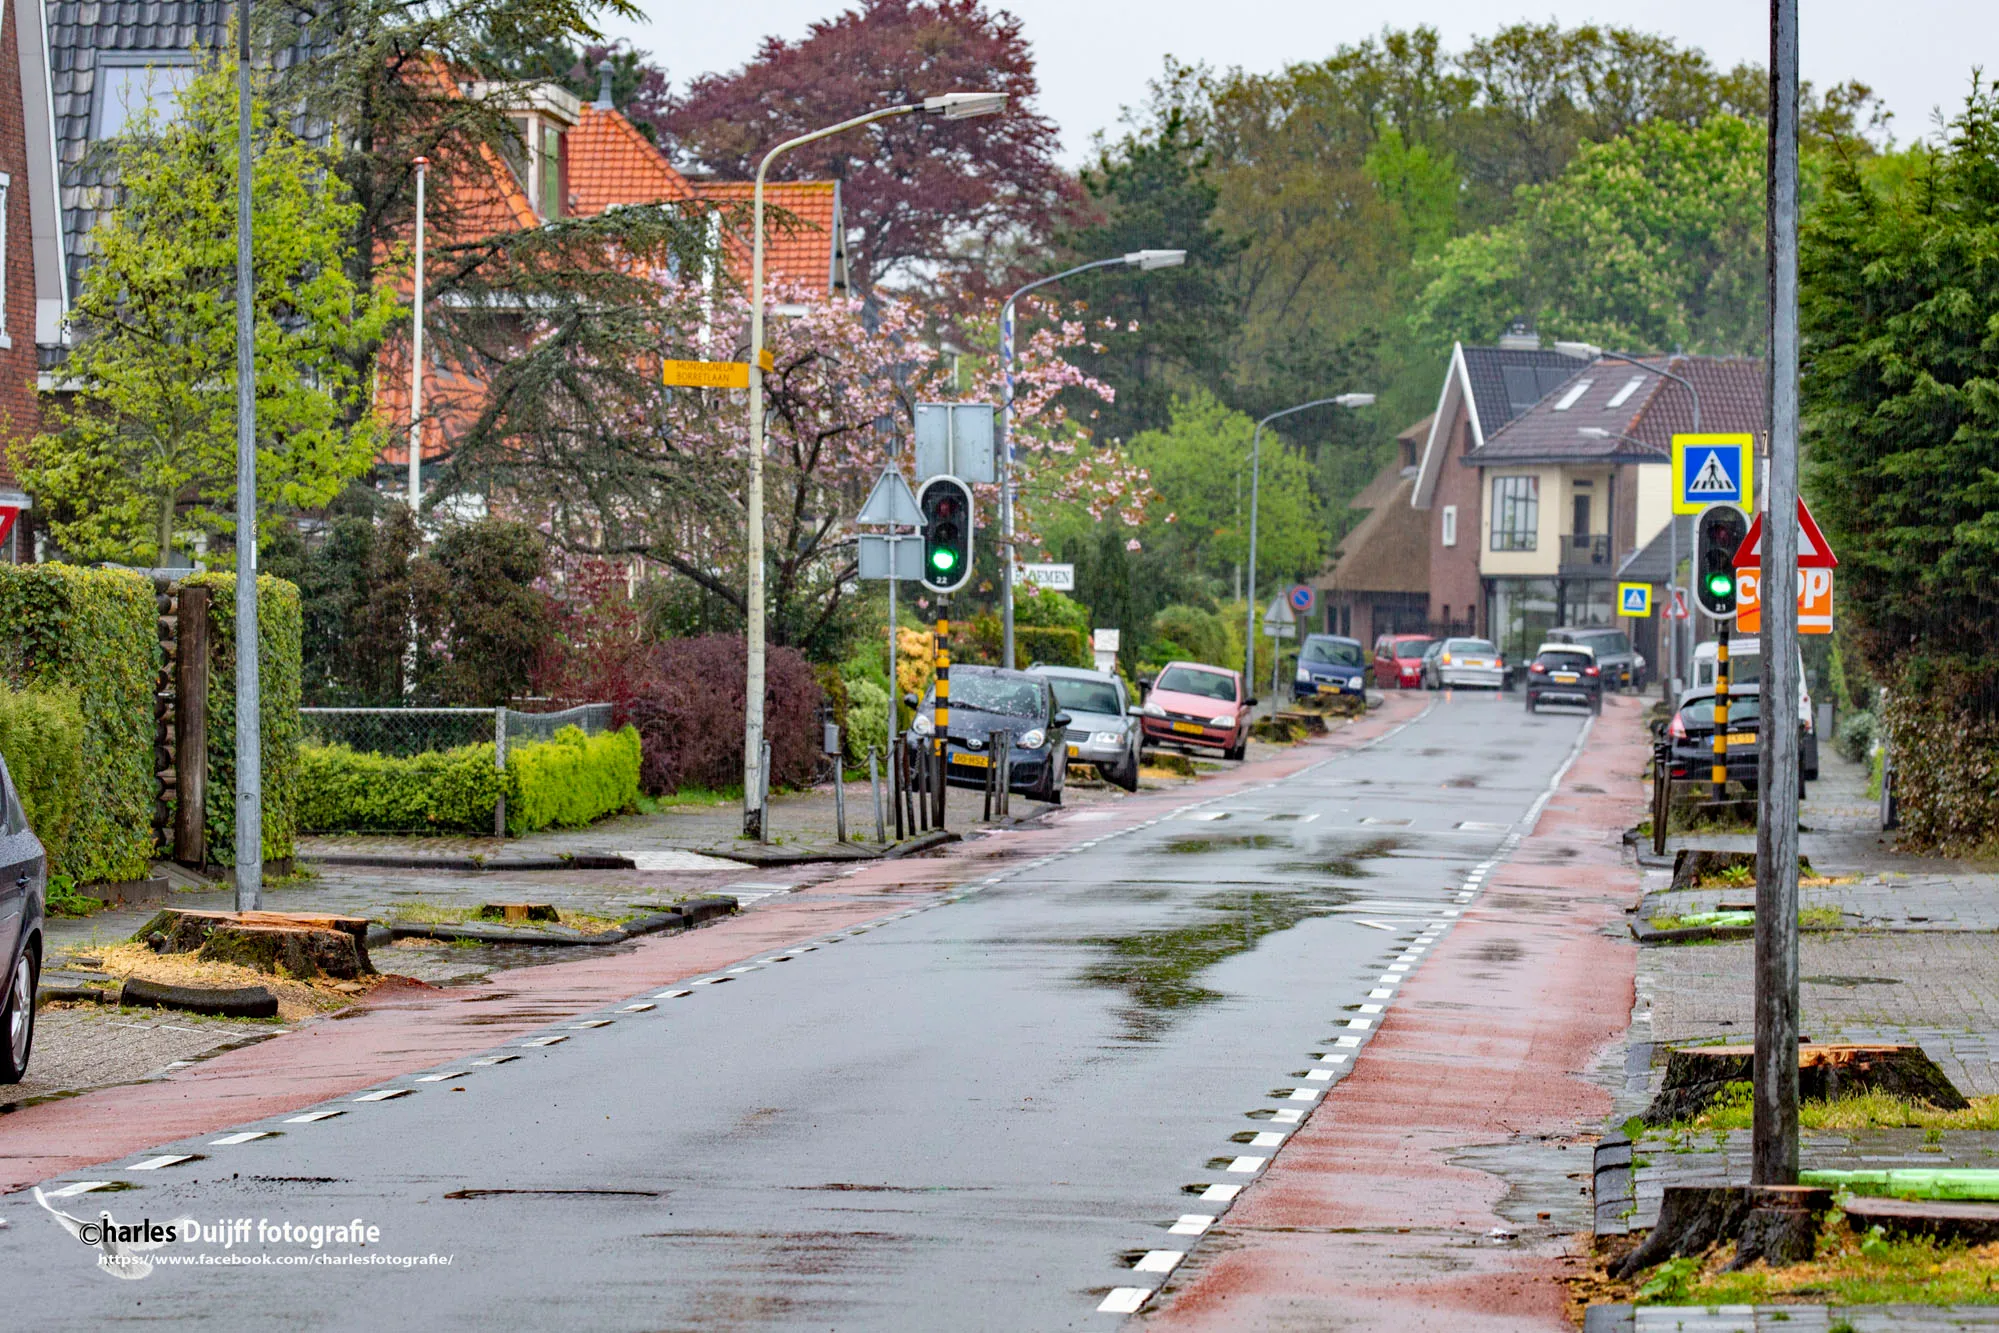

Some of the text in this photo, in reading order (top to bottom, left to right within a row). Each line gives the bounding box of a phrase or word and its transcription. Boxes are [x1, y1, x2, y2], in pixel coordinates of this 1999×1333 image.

[676, 362, 735, 372] MONSEIGNEUR
[676, 372, 730, 382] BORRETLAAN
[936, 575, 948, 584] 22
[1737, 569, 1829, 609] cp
[1715, 603, 1727, 612] 21
